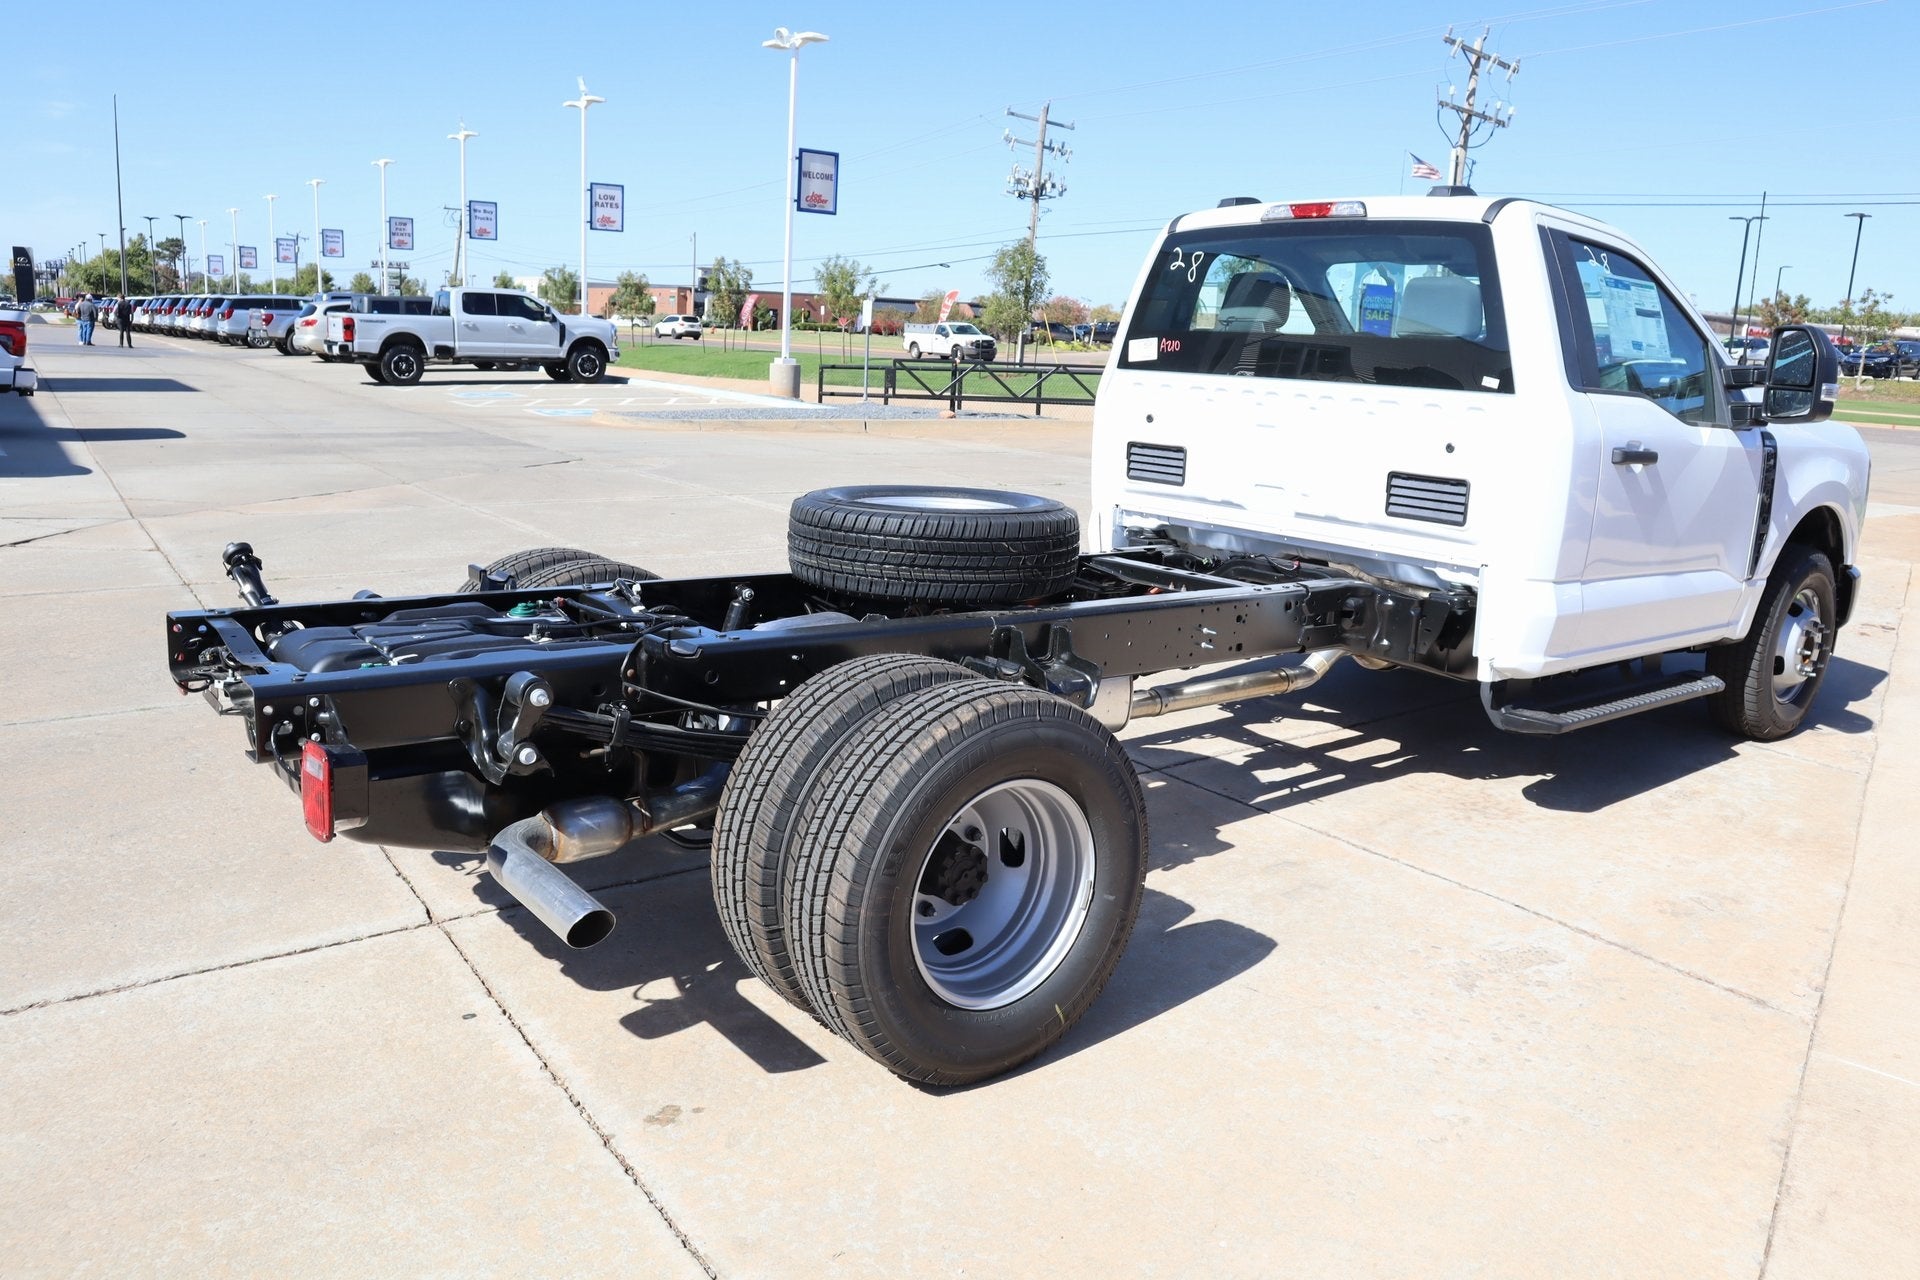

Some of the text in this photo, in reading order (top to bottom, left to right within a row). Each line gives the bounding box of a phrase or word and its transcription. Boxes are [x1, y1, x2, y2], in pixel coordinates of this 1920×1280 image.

[802, 170, 834, 181] WELCOME
[594, 201, 620, 209] RATES
[1169, 246, 1206, 283] 28
[1365, 309, 1391, 321] SALE
